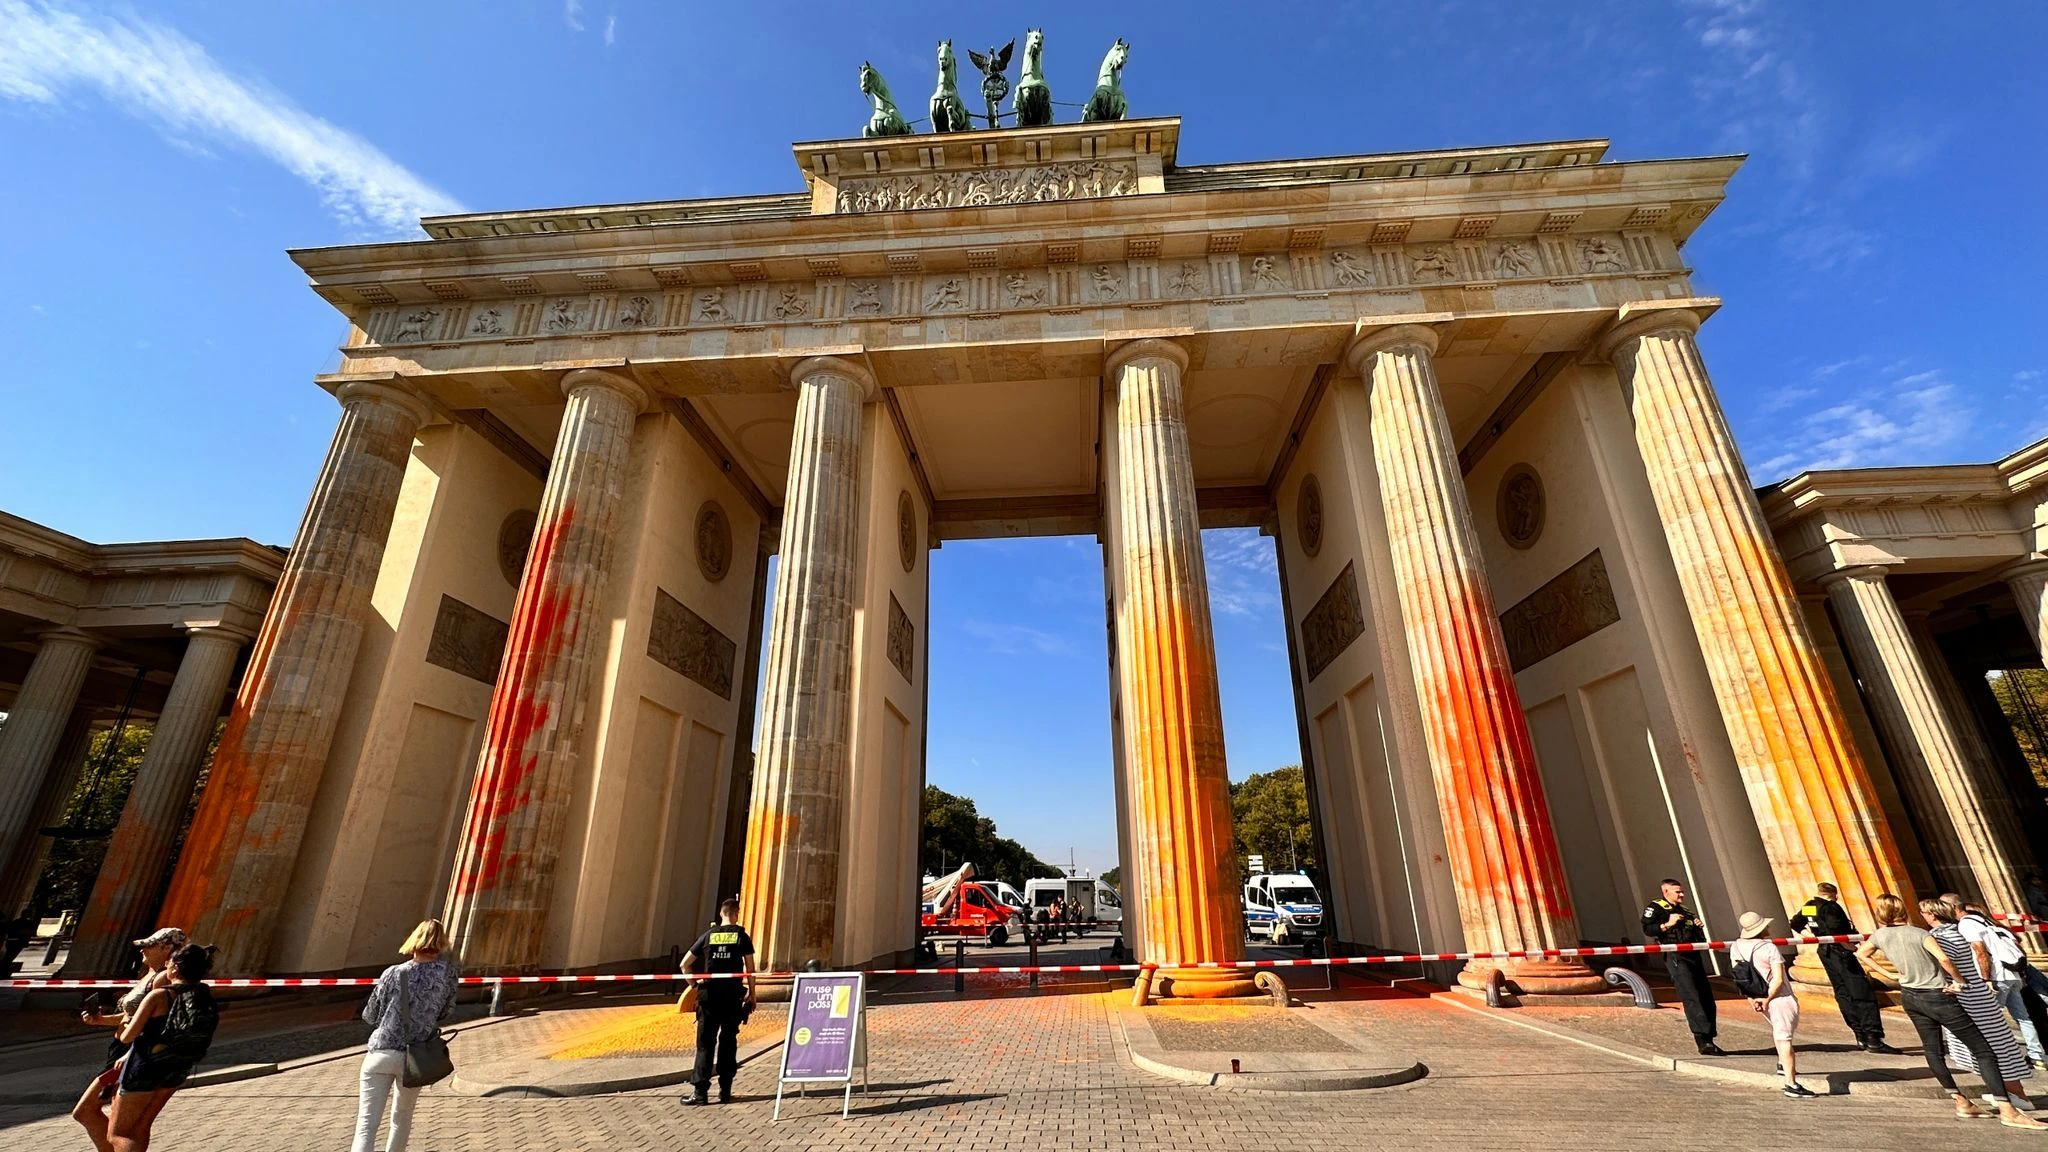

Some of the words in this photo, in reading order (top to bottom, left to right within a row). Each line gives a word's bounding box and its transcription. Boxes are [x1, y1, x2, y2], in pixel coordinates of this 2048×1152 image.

[804, 985, 832, 994] muse
[817, 993, 833, 1001] um
[808, 1000, 831, 1010] pass
